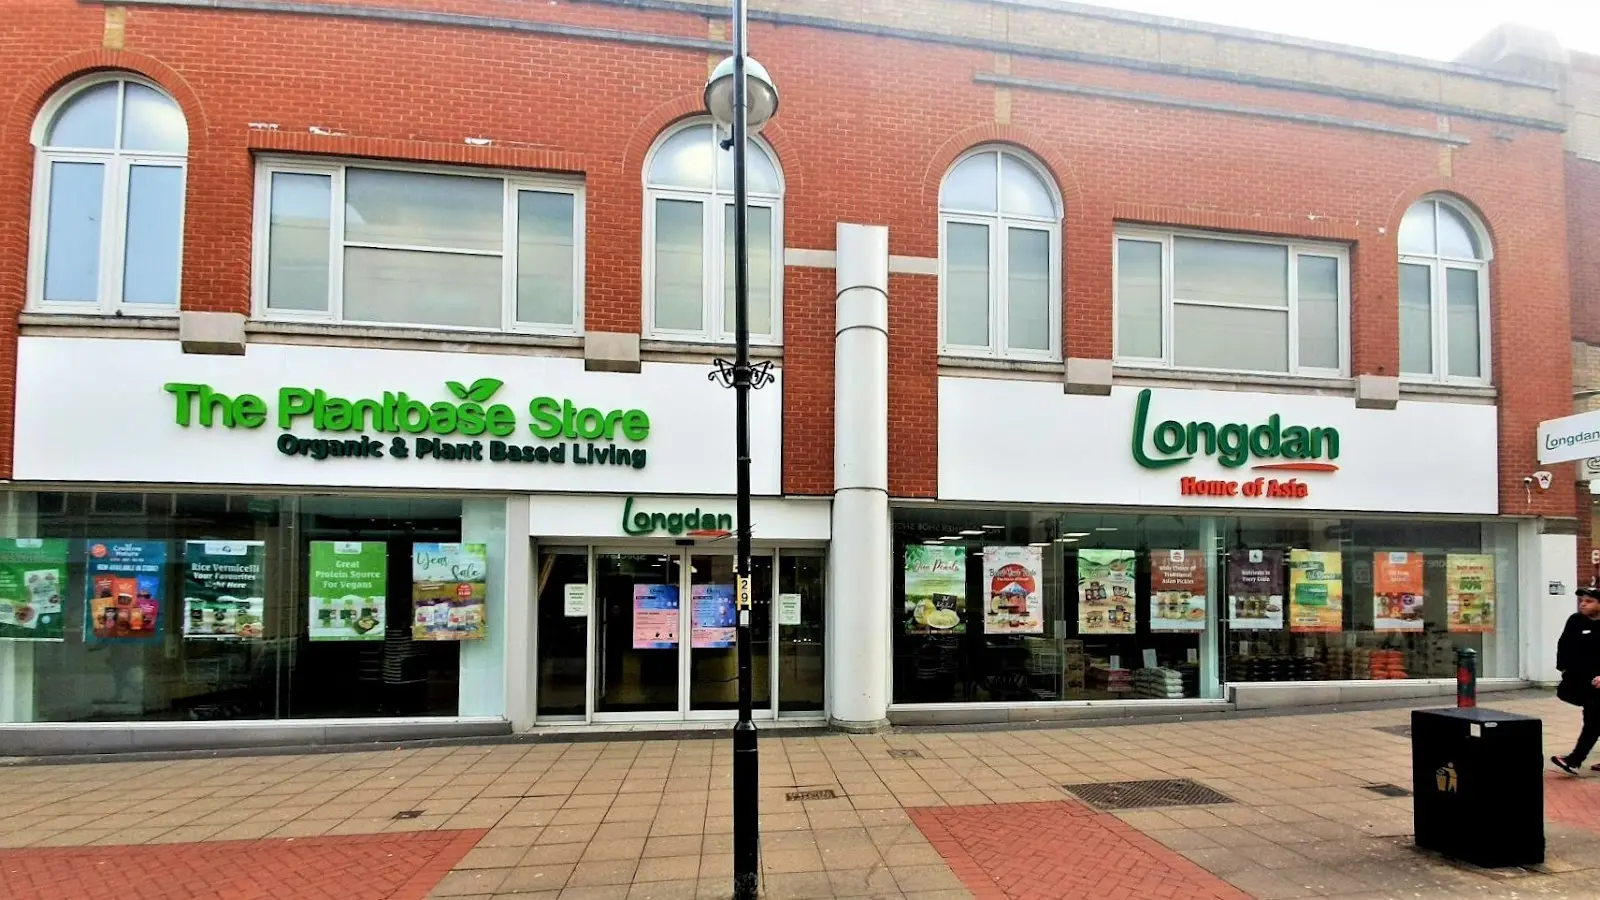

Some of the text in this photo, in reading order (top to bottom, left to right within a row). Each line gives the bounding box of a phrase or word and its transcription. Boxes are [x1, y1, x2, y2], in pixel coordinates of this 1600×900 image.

[164, 382, 650, 442] The Plantbase Store
[1132, 388, 1340, 469] Longdan
[1545, 430, 1600, 450] Longdan
[277, 433, 647, 469] Organic & Plant Based Living
[1180, 476, 1308, 498] Home of Asia
[622, 496, 732, 536] Longdan
[191, 563, 260, 573] Rice Vermicelli
[215, 573, 256, 581] Favourites
[315, 570, 348, 578] Protein
[452, 563, 480, 582] Sale
[340, 581, 372, 589] Vegans
